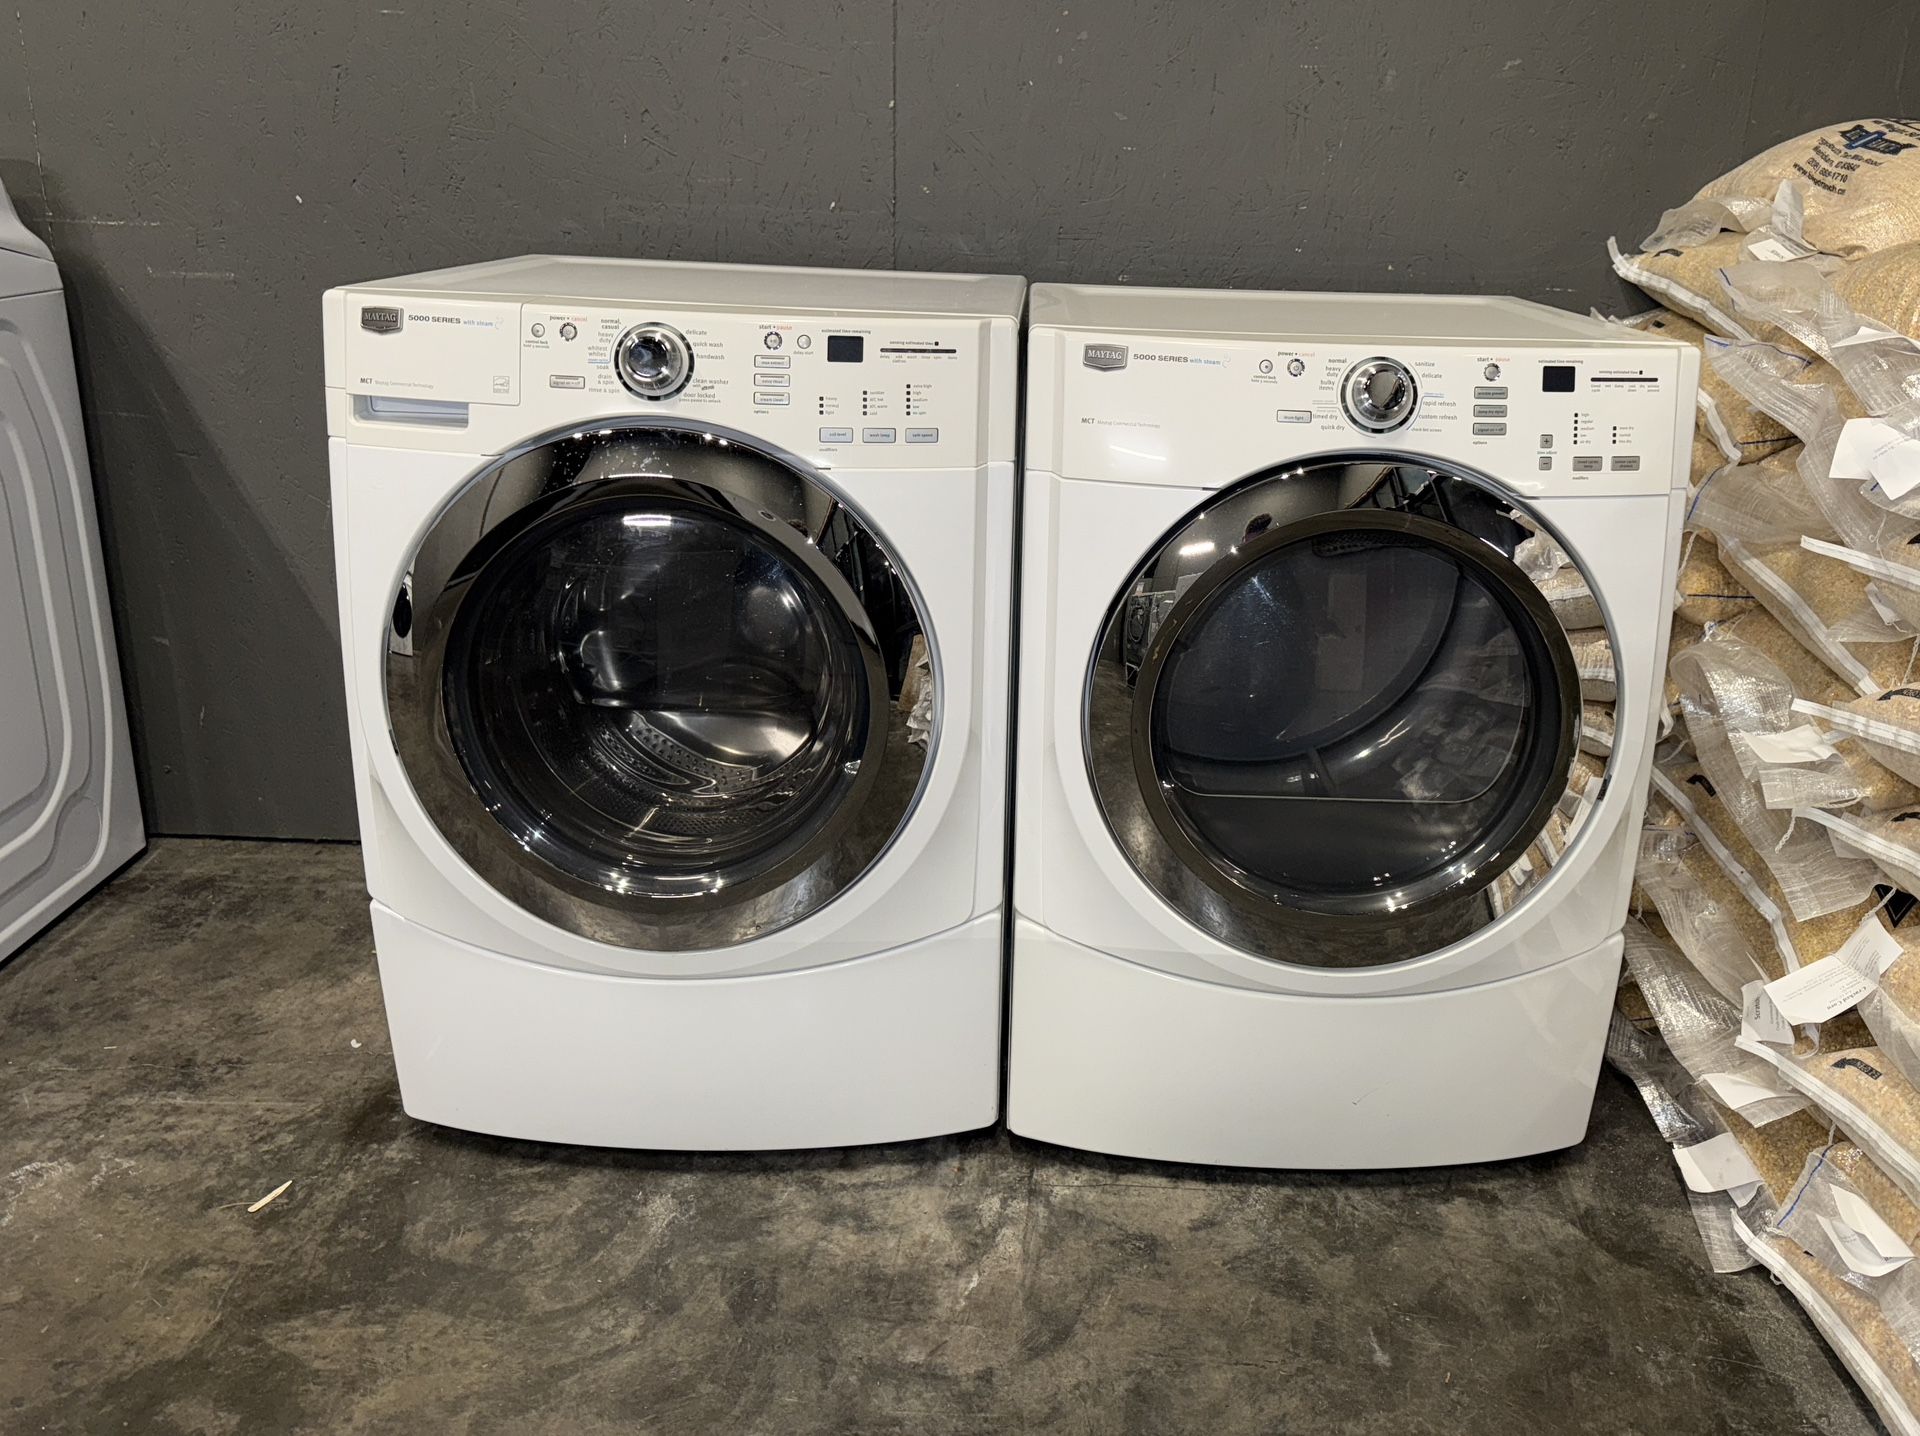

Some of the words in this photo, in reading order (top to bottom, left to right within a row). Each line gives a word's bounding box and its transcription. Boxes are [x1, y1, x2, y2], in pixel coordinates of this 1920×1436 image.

[364, 312, 397, 322] MAYTAG
[408, 314, 430, 322] 5000
[431, 316, 461, 324] SERIES
[476, 320, 493, 328] steam
[1087, 350, 1122, 360] MAYTAG
[1133, 353, 1156, 361] 5000
[1157, 354, 1189, 363] SERIES
[1203, 358, 1221, 366] steam
[360, 377, 373, 385] MCT
[1081, 417, 1095, 425] MCT
